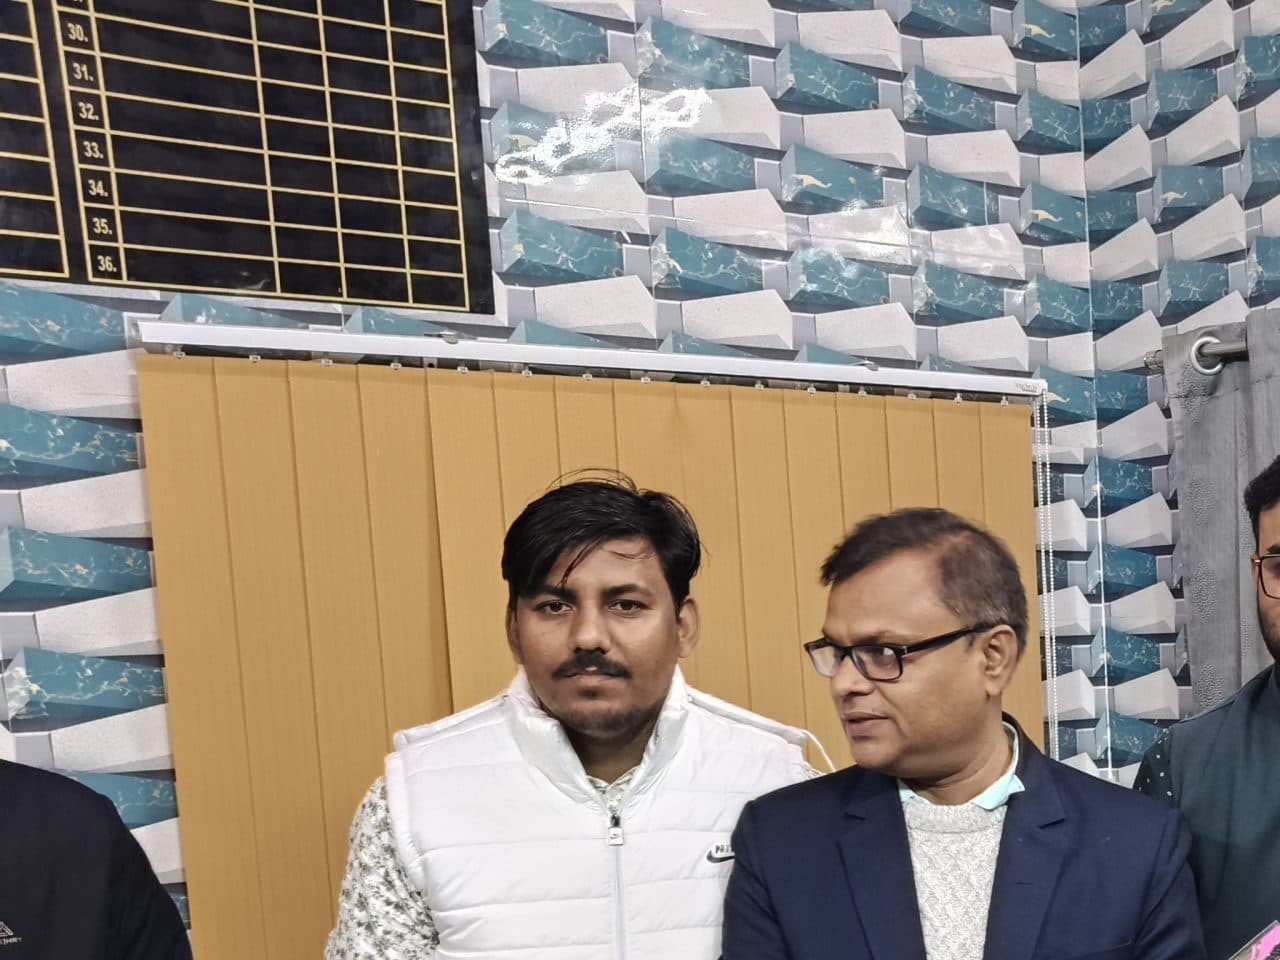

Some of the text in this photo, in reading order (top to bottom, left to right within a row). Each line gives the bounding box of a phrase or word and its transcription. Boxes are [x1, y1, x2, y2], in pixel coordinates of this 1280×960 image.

[67, 22, 88, 42] 30.
[72, 62, 94, 81] 31.
[78, 101, 99, 120] 32.
[83, 140, 104, 159] 33.
[88, 179, 108, 197] 34.
[92, 217, 113, 235] 35.
[97, 255, 117, 273] 36.
